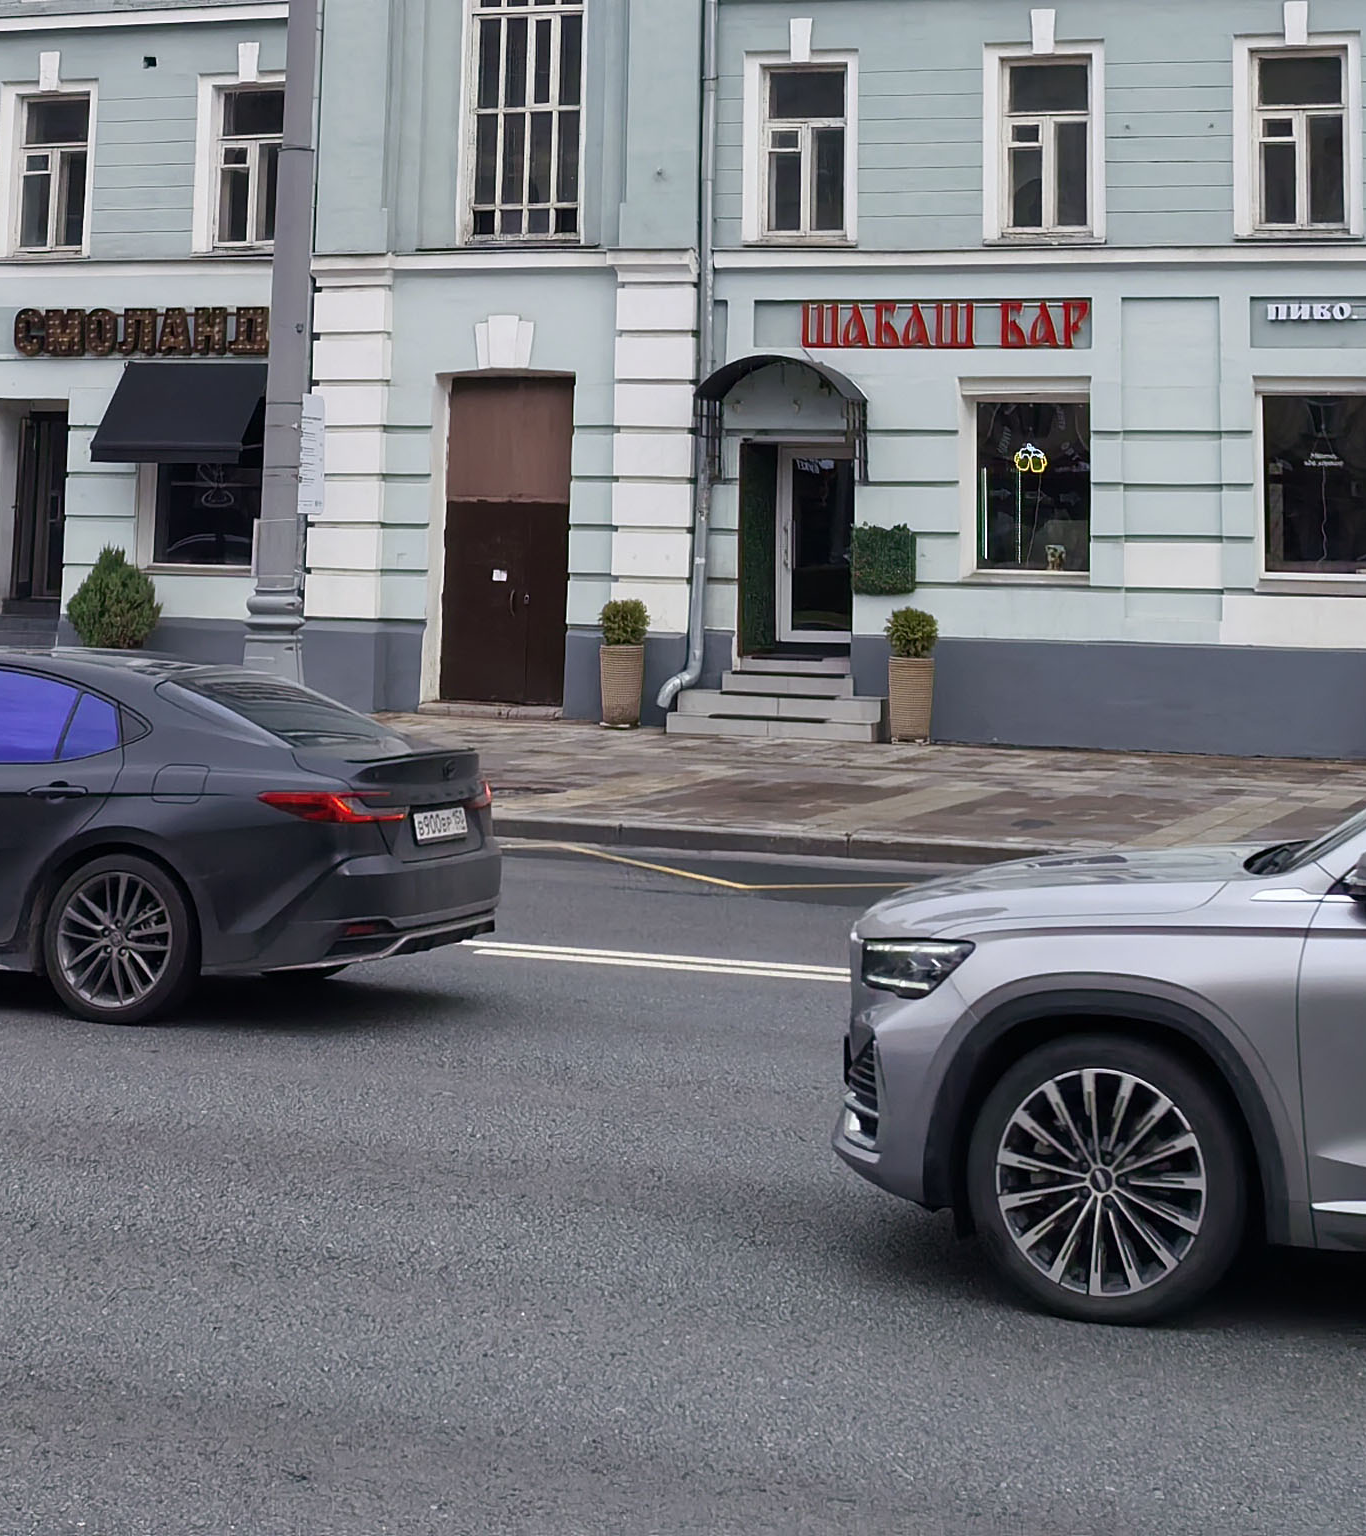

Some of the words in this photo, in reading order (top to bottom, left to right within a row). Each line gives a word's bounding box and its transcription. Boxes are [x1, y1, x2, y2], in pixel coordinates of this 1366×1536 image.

[14, 307, 269, 357] СМОЛАНД
[801, 302, 975, 349] ШАБАШ
[1000, 301, 1090, 349] БАР
